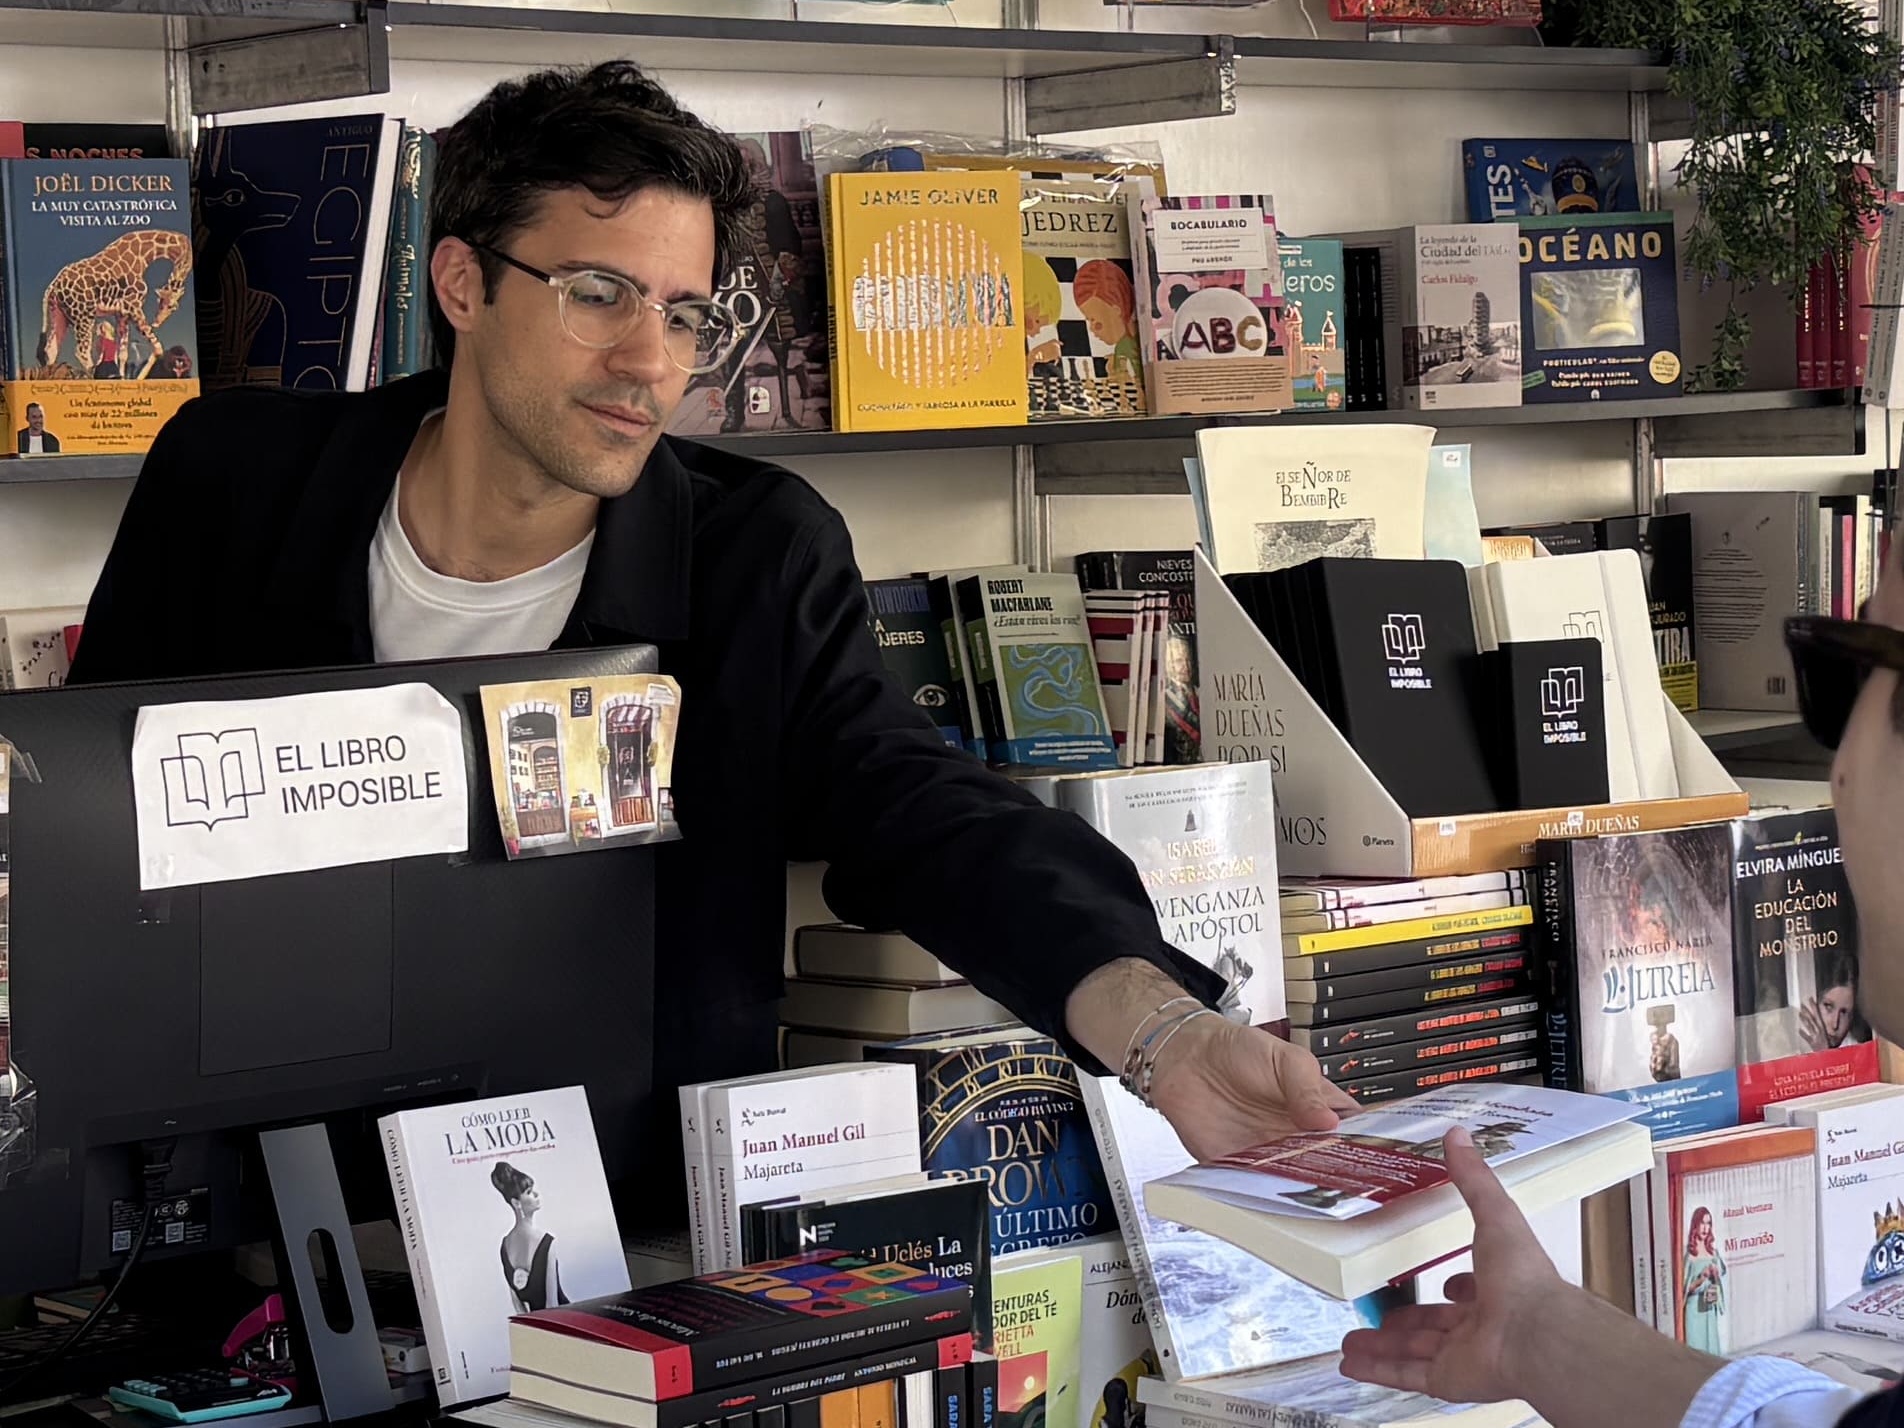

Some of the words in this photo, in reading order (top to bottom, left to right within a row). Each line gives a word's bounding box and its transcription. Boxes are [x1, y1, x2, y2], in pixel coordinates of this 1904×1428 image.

[34, 173, 83, 196] JOËL
[90, 174, 173, 193] DICKER
[859, 189, 921, 206] JAMIE
[928, 188, 998, 205] OLIVER
[31, 200, 48, 211] LA
[51, 200, 79, 213] MUY
[82, 198, 178, 213] CATASTRÓFICA
[60, 214, 100, 227] VISITA
[104, 214, 120, 226] AL
[123, 214, 151, 226] ZOO
[1170, 216, 1247, 232] BOCABULARIO
[1519, 228, 1662, 264] OCÉANO
[1180, 315, 1263, 354] ABC
[275, 745, 313, 774] EL
[321, 734, 407, 771] LIBRO
[281, 772, 443, 814] IMPOSIBLE
[1754, 891, 1838, 919] EDUCACIÓN
[1759, 930, 1838, 958] MONSTRUO
[445, 1129, 479, 1158] LA
[486, 1120, 557, 1151] MODA
